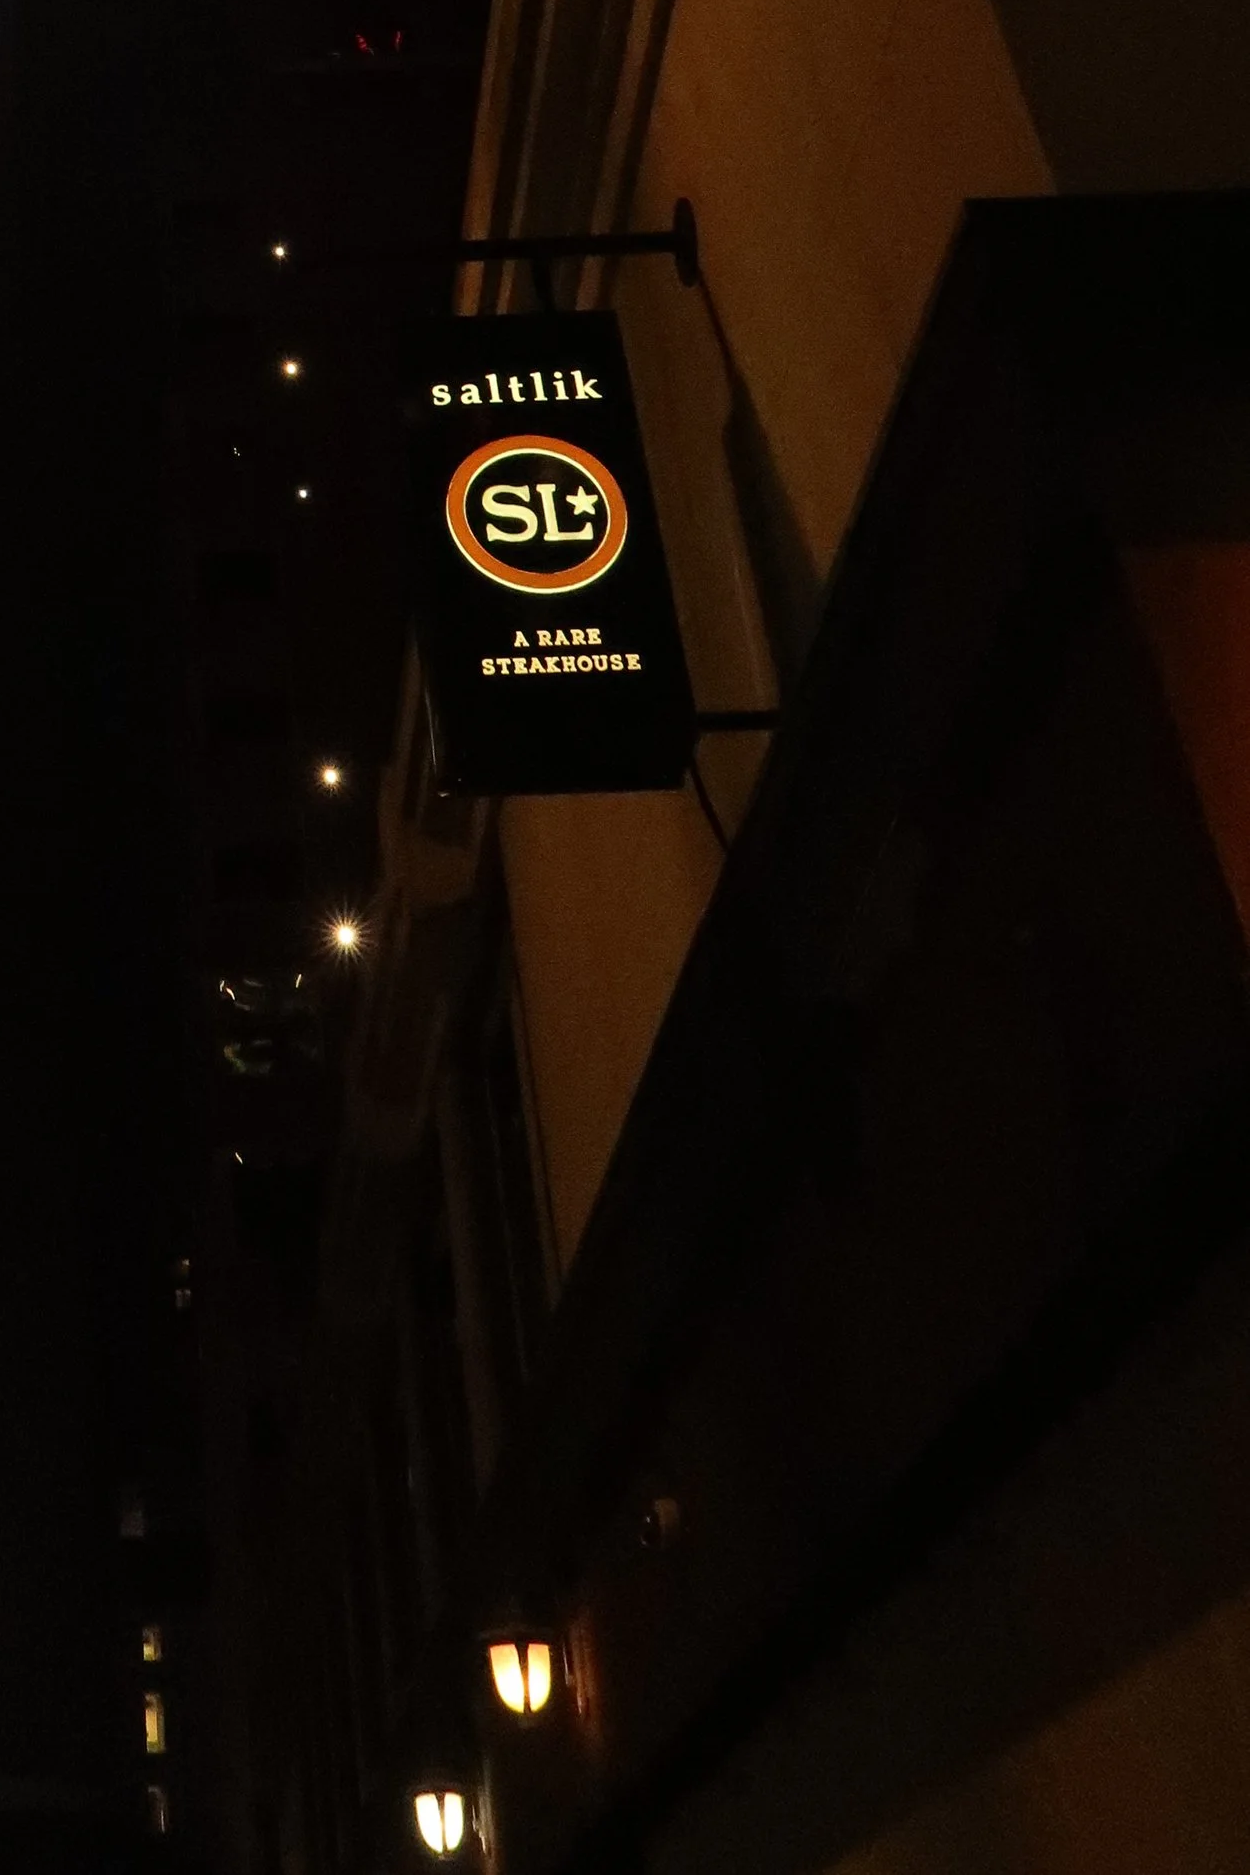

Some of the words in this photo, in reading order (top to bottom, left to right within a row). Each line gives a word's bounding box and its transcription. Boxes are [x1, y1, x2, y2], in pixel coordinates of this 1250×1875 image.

[431, 369, 603, 407] saltlik
[481, 483, 594, 543] SL
[513, 630, 530, 647] A
[536, 628, 602, 647] RARE
[481, 653, 642, 676] STEAKHOUSE
